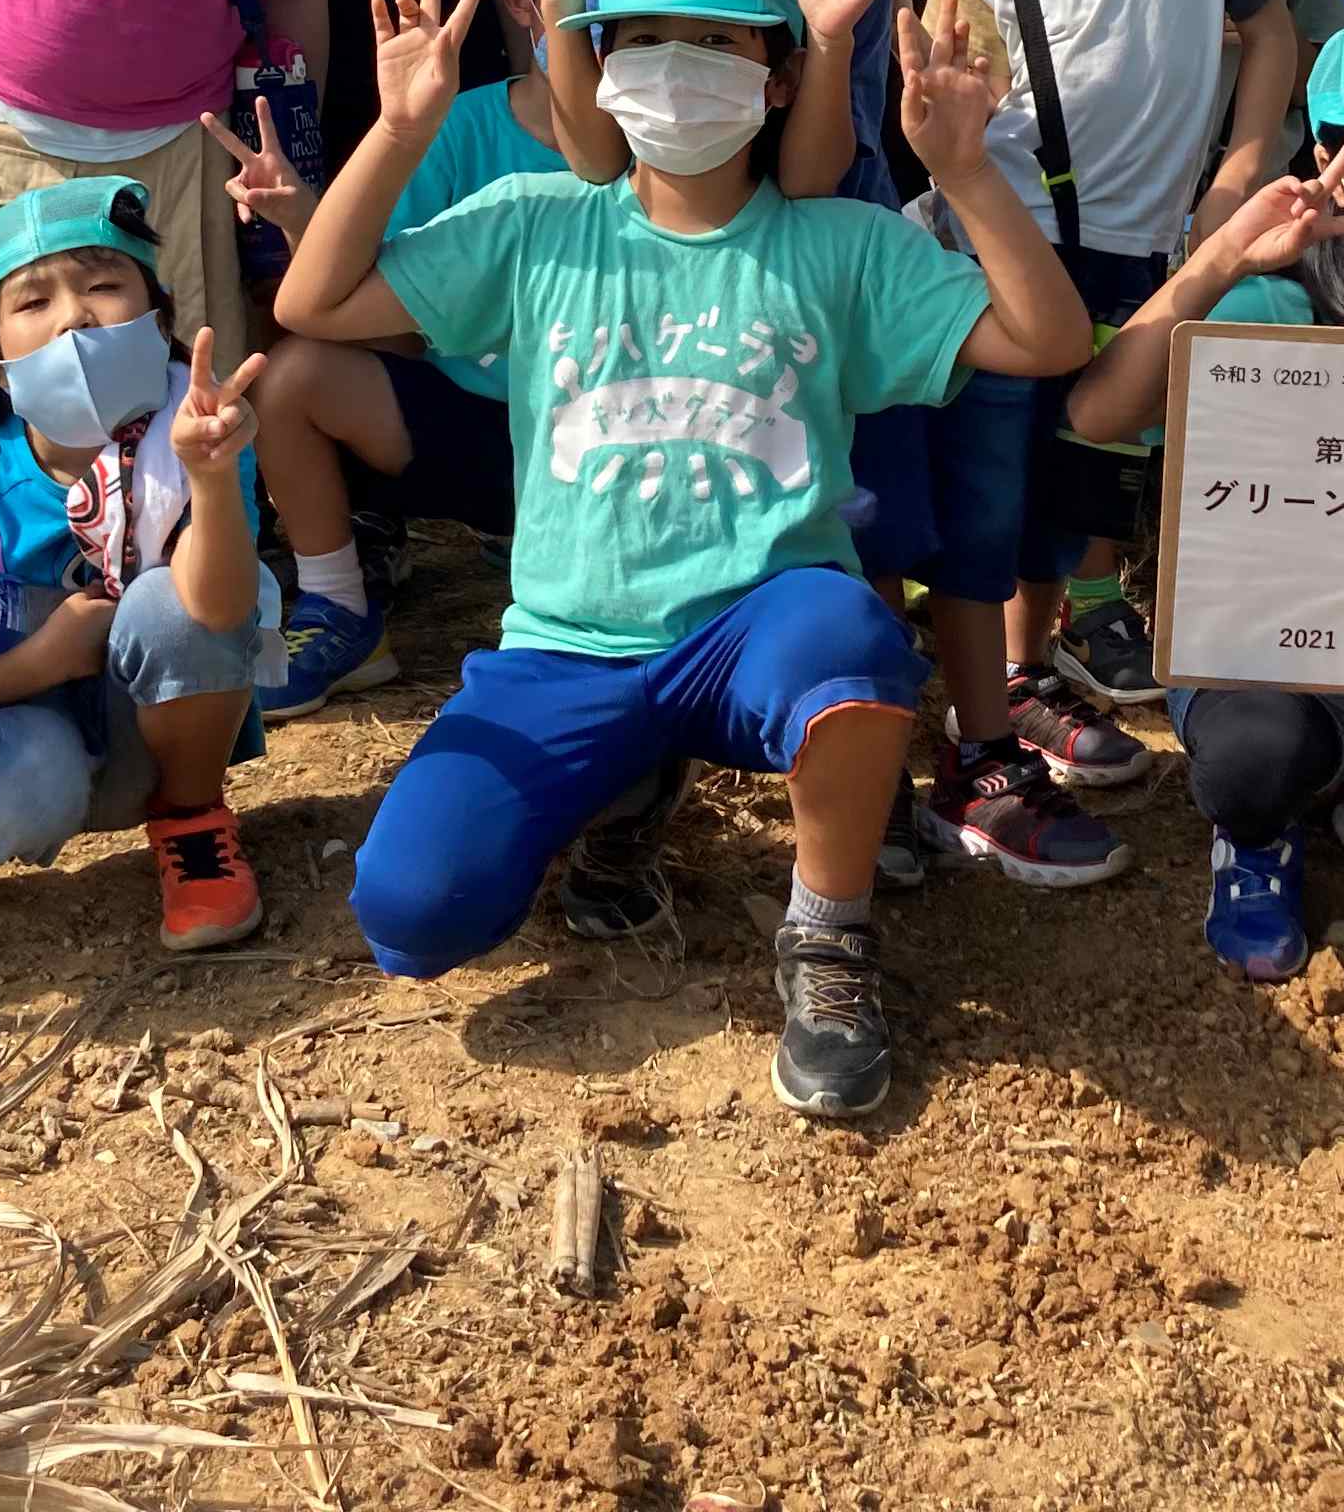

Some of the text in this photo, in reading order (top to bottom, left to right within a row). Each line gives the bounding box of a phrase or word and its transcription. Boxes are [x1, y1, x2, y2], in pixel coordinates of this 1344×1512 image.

[586, 305, 775, 376] ハゲーラ
[591, 393, 776, 434] キッズクラブ
